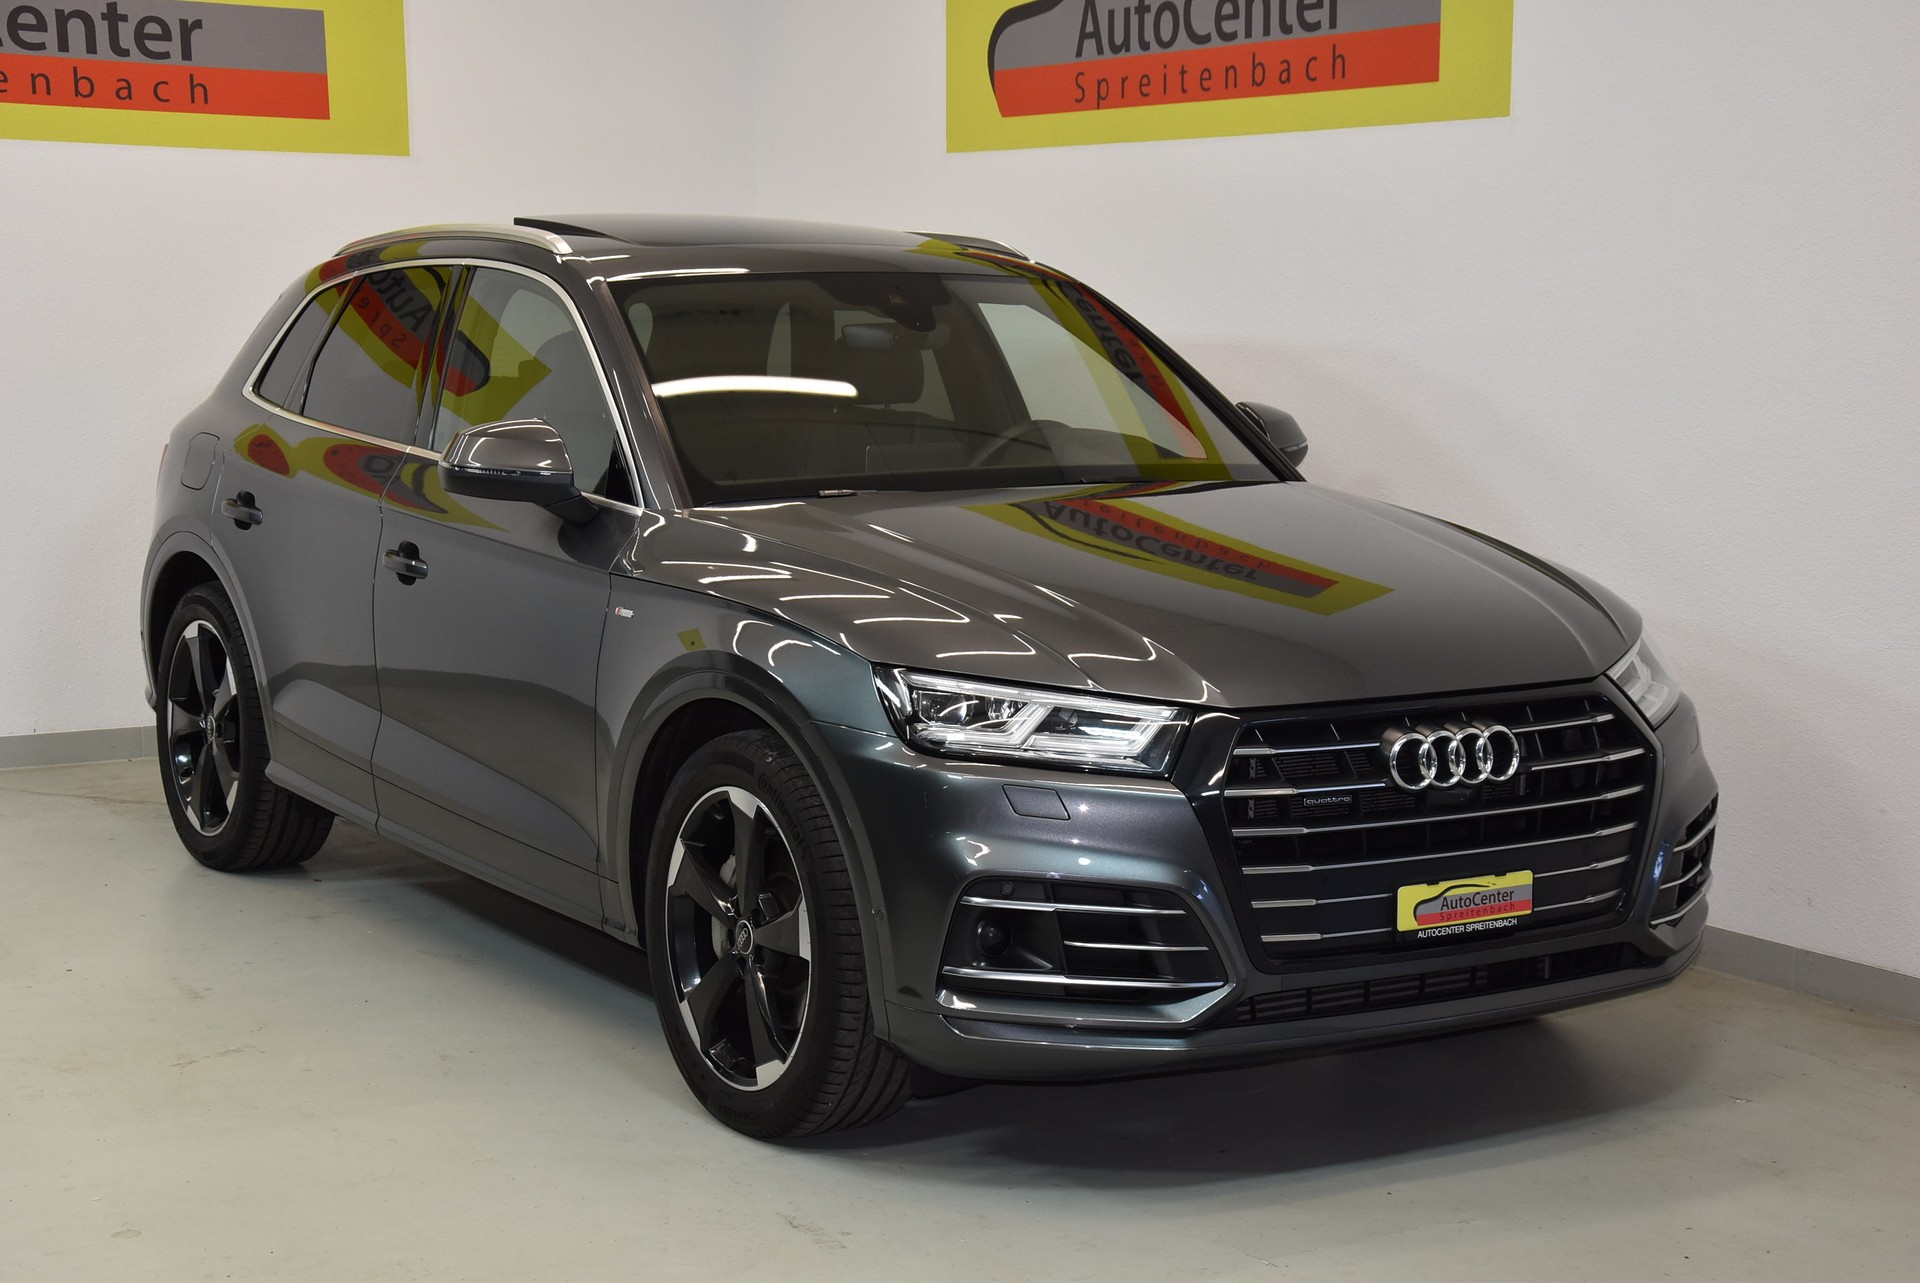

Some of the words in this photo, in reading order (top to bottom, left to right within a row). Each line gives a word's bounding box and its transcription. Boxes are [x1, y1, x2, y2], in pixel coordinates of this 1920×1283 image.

[0, 0, 203, 62] enter
[1075, 43, 1346, 109] Spreitenbach
[1306, 796, 1351, 805] quattro
[1440, 889, 1515, 911] AutoCenter
[1439, 902, 1516, 922] Spreitenbach
[1417, 924, 1465, 938] AUTOCENTER
[1465, 918, 1518, 933] SPREITENBACH
